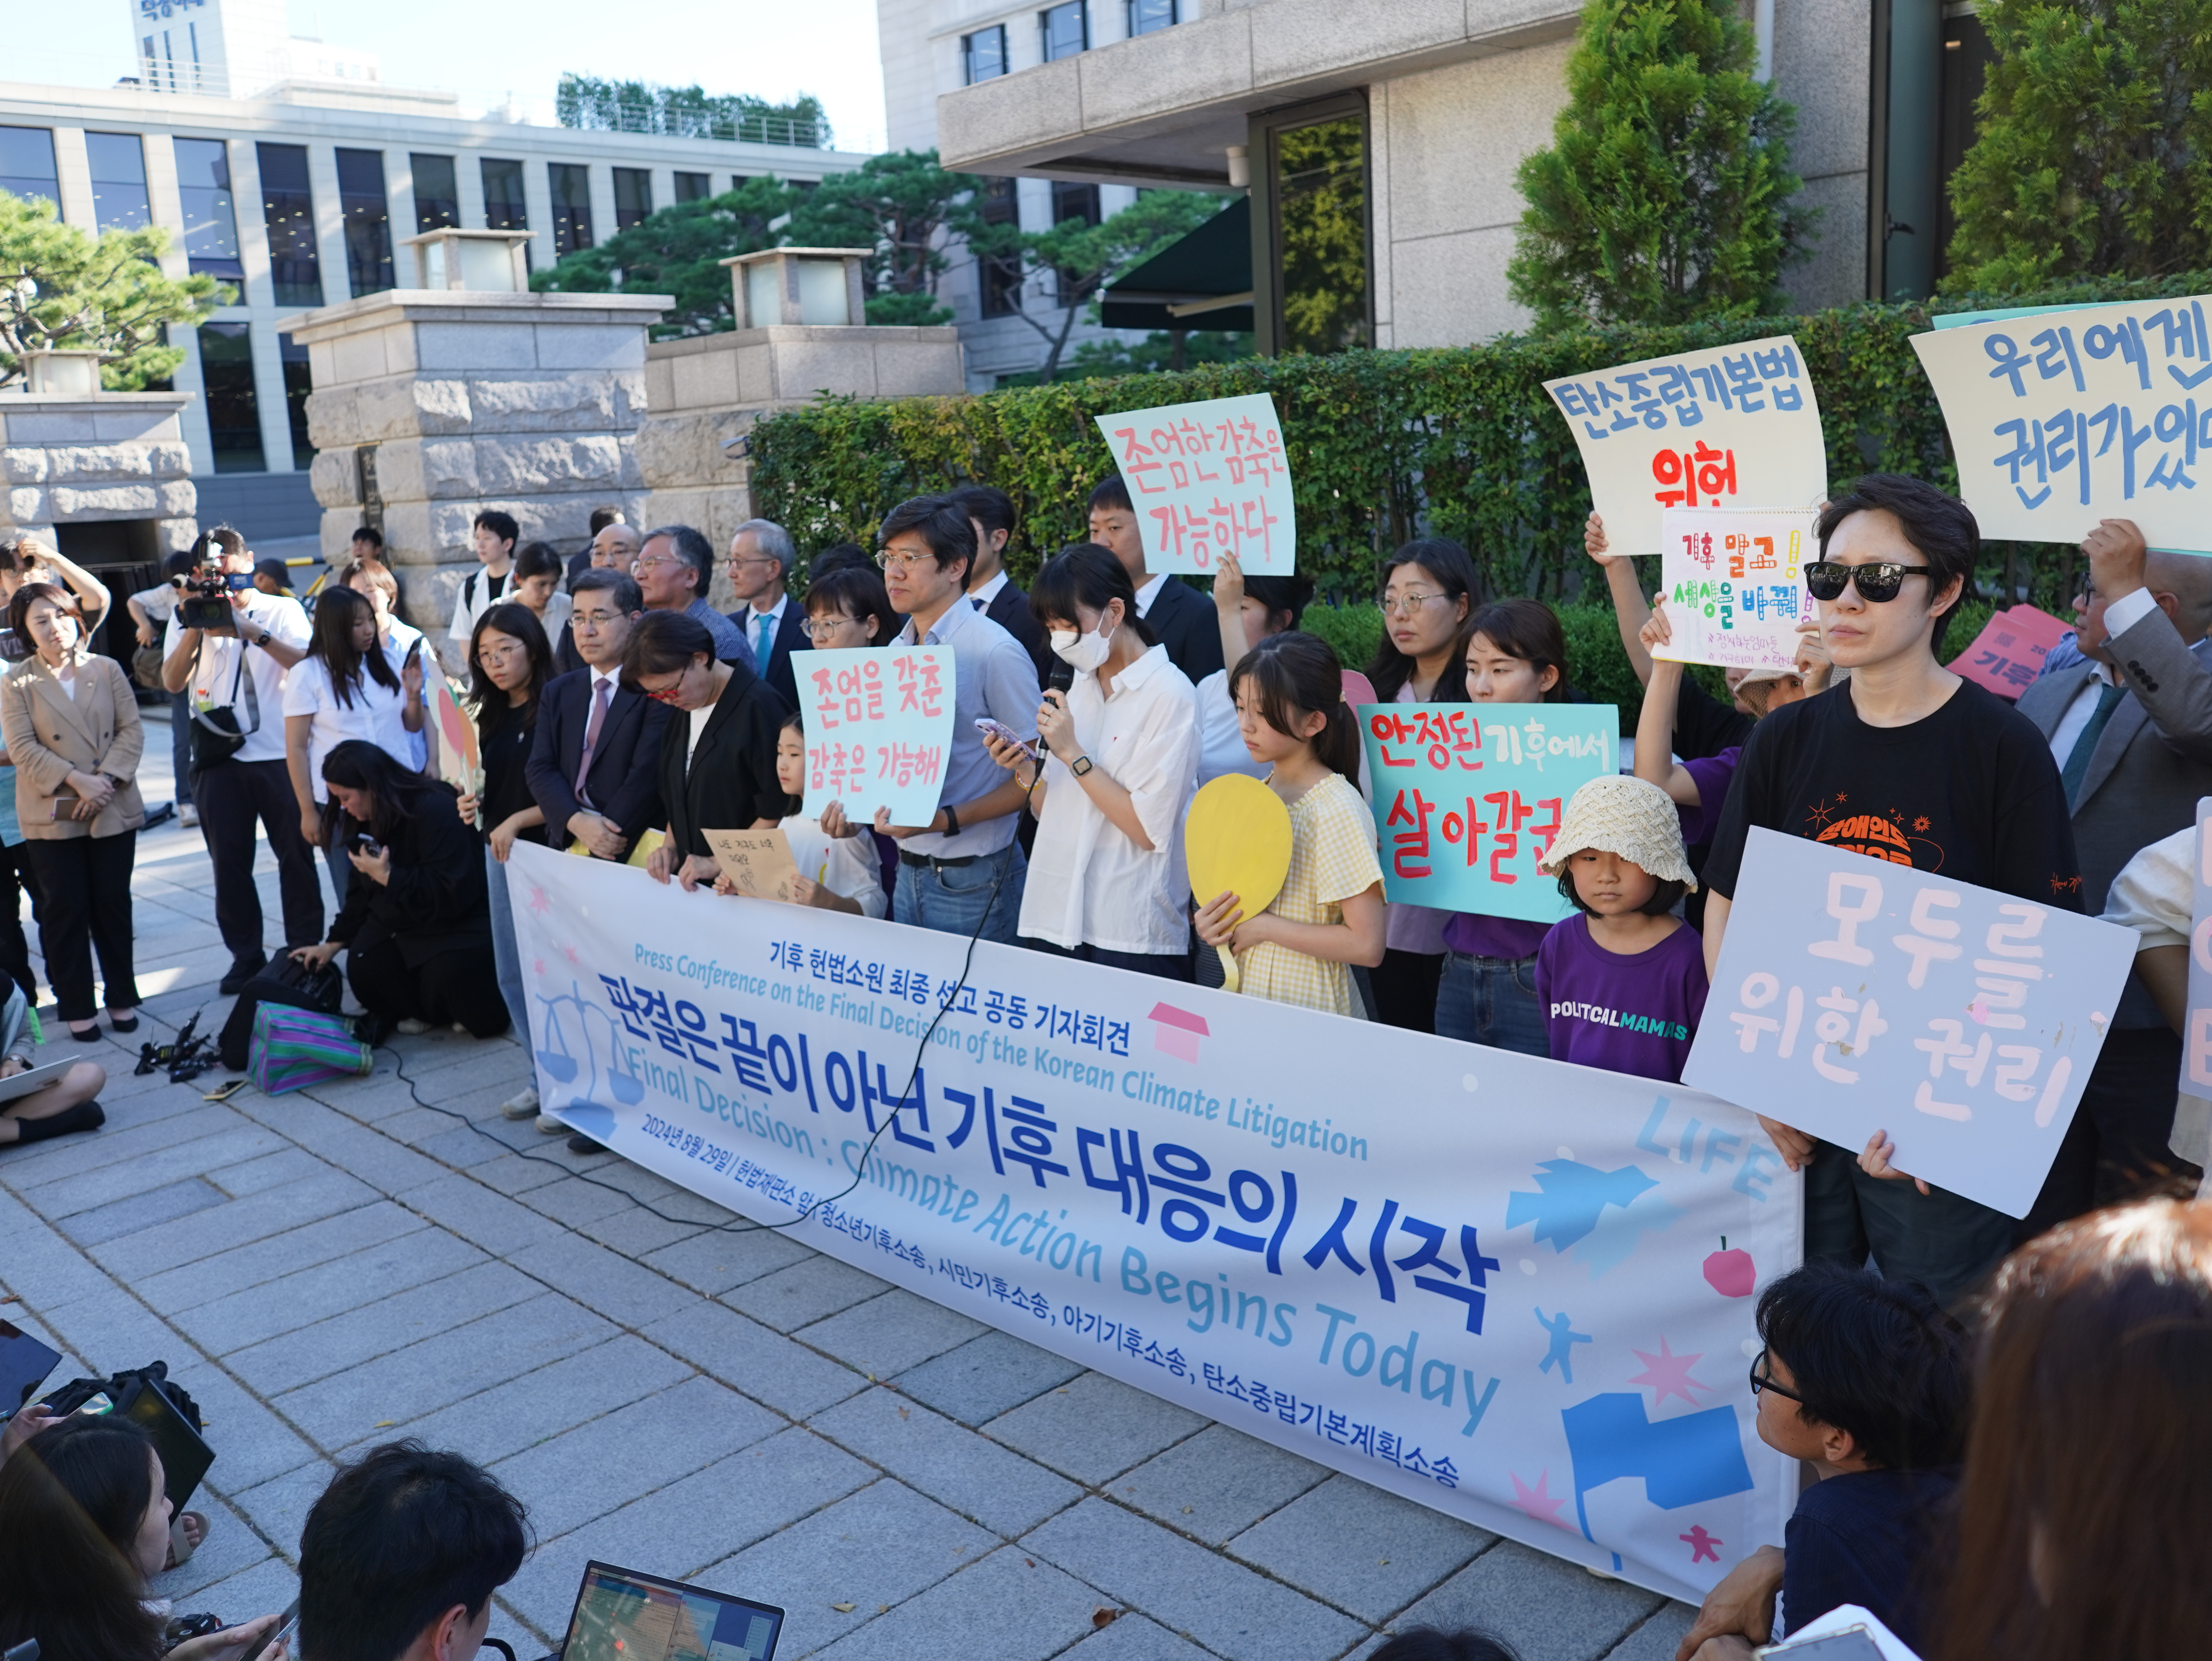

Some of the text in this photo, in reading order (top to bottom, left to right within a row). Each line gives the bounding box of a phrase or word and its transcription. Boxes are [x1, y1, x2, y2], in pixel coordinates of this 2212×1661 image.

[1553, 345, 1803, 439] 탄소중립기본법
[1984, 300, 2212, 397] 우리에겐
[1149, 495, 1278, 568] 가능하다
[1682, 532, 1715, 570] 기후
[1674, 580, 1734, 629] 세상을
[811, 654, 943, 730] 존엄을 갖춘
[1371, 711, 1610, 772] 안정된 기후에서
[808, 742, 941, 796] 감축은 가능해
[770, 941, 1130, 1058] 기후 헌법소원 최종 선고 공동 기자회견
[1808, 871, 2048, 1030] 모두를
[635, 943, 1368, 1161] Press Conference on the Final Decision of the Korean Climate Litigation
[1729, 971, 1889, 1085] 위한
[1913, 1019, 2072, 1129] 권리
[598, 973, 1501, 1336] 판결은 끝이 아닌 기후 대응의 시작
[1635, 1095, 1784, 1204] LIFE
[627, 1046, 689, 1103] Final
[694, 1075, 815, 1158] Decision
[841, 1139, 979, 1224] Climate
[973, 1193, 1103, 1283] Action
[1121, 1245, 1297, 1347] Begins
[1315, 1302, 1502, 1438] Today
[642, 1114, 684, 1148] 2024년
[680, 1134, 705, 1158] 8월
[699, 1144, 734, 1173] 29일
[734, 1160, 796, 1206] 헌법재판소
[796, 1191, 815, 1217] 앞
[820, 1199, 934, 1275] 청소년기후소송,
[938, 1258, 1056, 1326] 시민기후소송,
[1063, 1305, 1197, 1385] 아기기후소송,
[1203, 1362, 1460, 1489] 탄소중립기본계획소송
